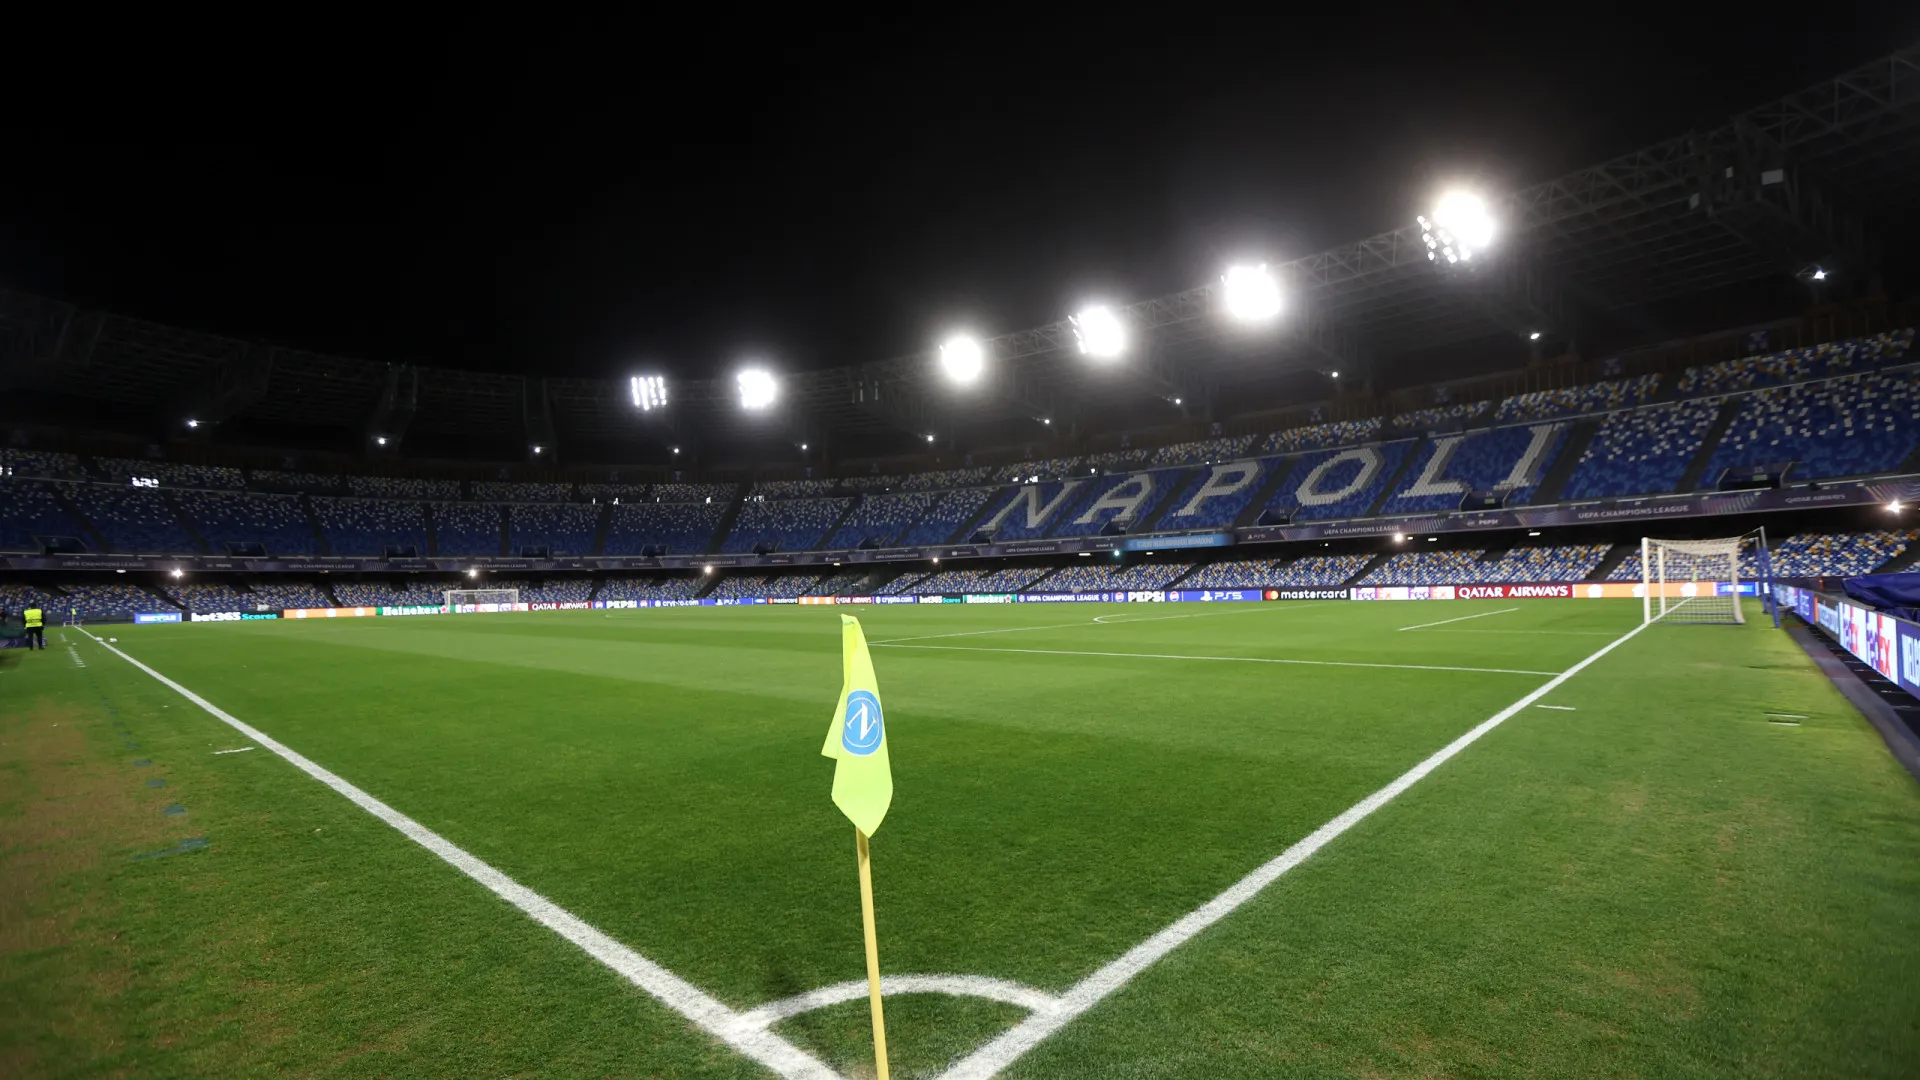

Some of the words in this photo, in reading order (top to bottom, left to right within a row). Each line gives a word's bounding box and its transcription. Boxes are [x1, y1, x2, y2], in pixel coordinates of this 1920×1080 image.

[977, 421, 1567, 531] NAPOLI
[1600, 508, 1652, 518] CHAMPIONS
[1653, 505, 1689, 514] LEAGUE
[1376, 524, 1400, 532] LEAGUE
[1128, 591, 1165, 602] PEPSI
[1214, 591, 1243, 600] PS5
[1280, 589, 1347, 599] mastercard
[1458, 587, 1503, 598] QATAR
[1508, 585, 1568, 597] AIRWAYS
[881, 595, 914, 604] crypto.com
[1042, 594, 1075, 602] CHAMPIONS
[1076, 594, 1100, 602] LEAGUE
[532, 603, 557, 611] QATAR
[559, 601, 589, 610] AIRWAYS
[606, 600, 638, 609] PEPSI
[382, 606, 439, 616] Heineken
[191, 612, 241, 622] bet365
[846, 702, 877, 741] N
